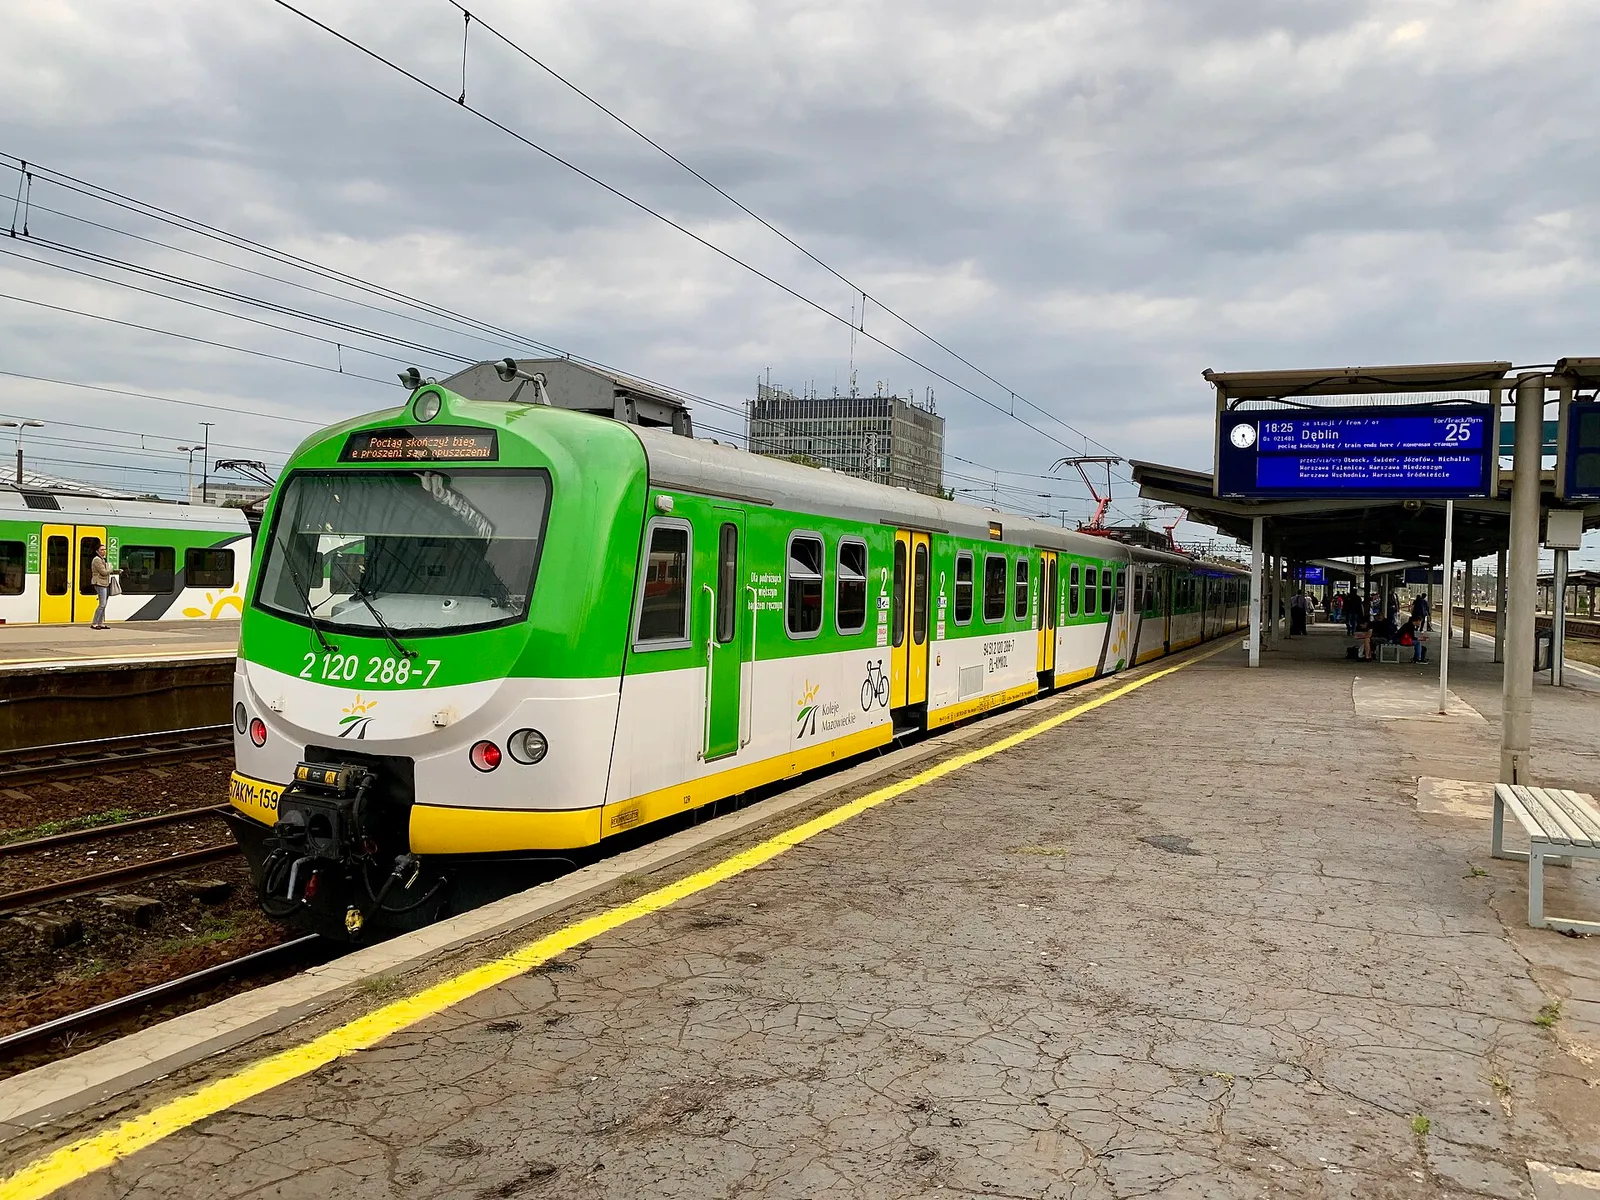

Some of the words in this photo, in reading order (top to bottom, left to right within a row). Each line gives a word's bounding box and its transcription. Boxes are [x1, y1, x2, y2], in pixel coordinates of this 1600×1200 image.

[1265, 422, 1294, 433] 18:25
[1445, 423, 1471, 441] 25
[1301, 429, 1339, 441] Dęblin
[369, 437, 403, 449] Pociąg
[405, 436, 449, 448] skończył
[360, 447, 403, 459] proszeni
[30, 535, 38, 545] 2
[110, 538, 117, 548] 2
[880, 567, 888, 596] 2
[940, 571, 946, 596] 2
[300, 653, 316, 679] 2
[321, 653, 360, 681] 120
[364, 657, 442, 687] 288-7
[821, 701, 840, 717] Koleje
[821, 713, 856, 732] Mazowieckie
